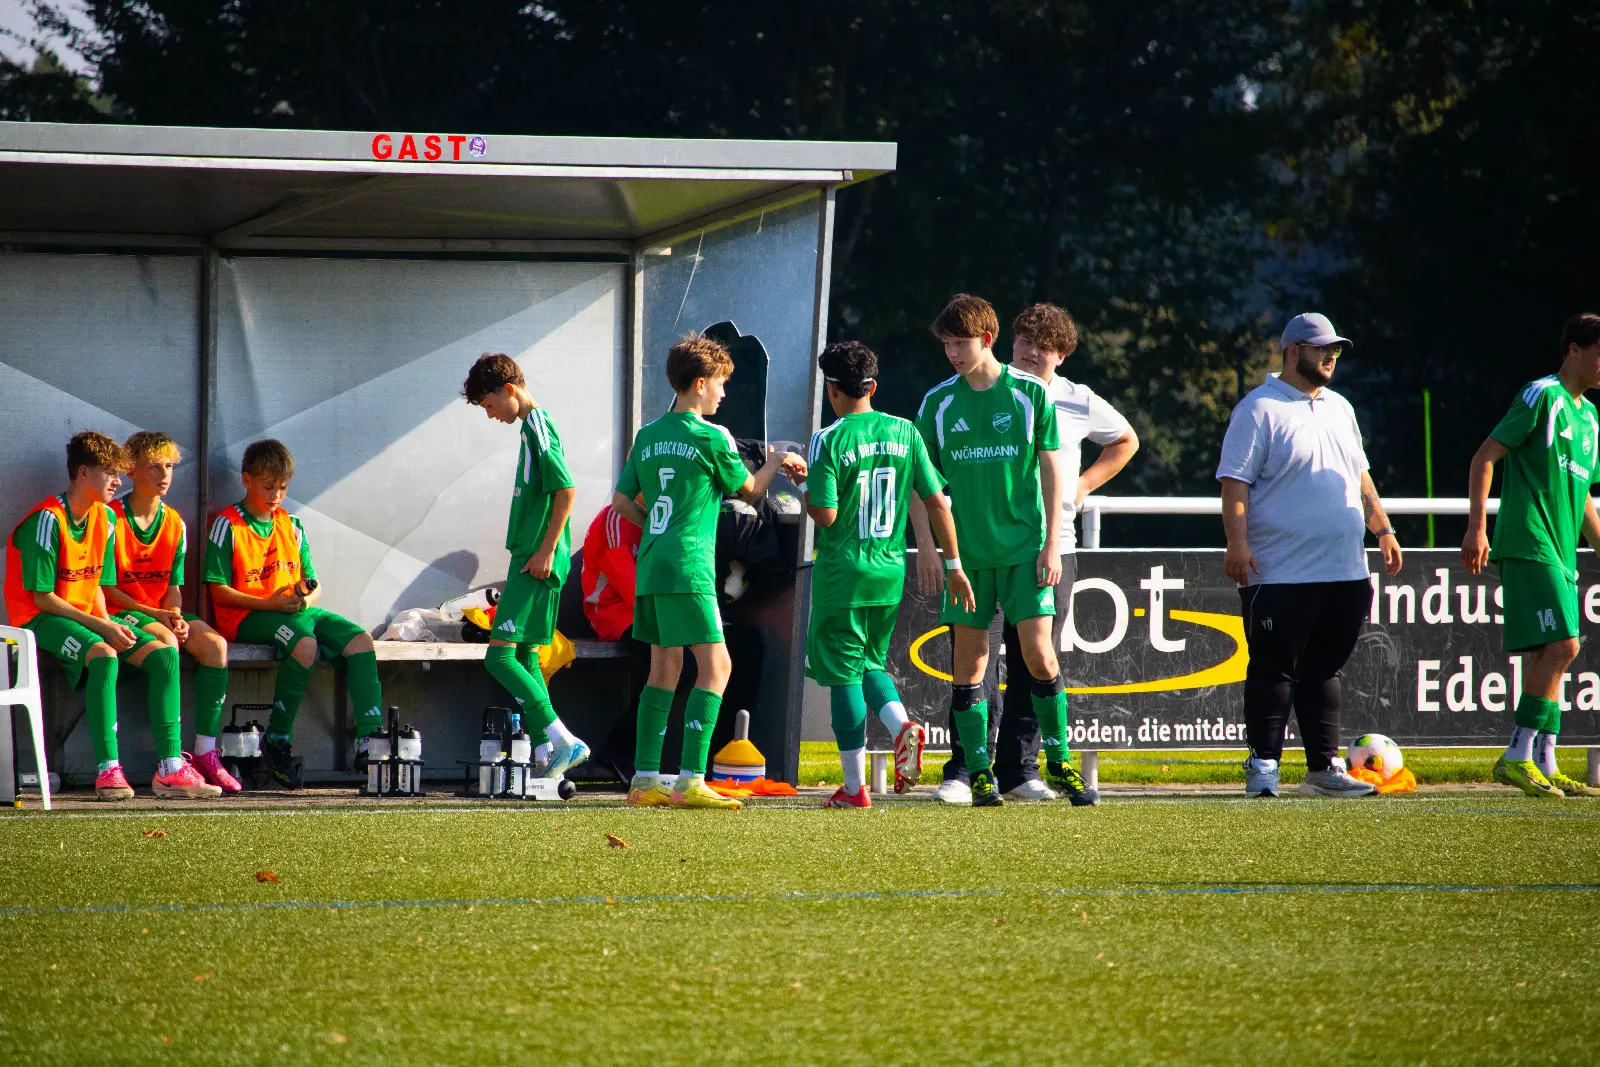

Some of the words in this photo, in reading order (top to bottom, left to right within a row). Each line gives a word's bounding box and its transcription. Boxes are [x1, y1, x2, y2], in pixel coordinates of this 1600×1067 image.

[371, 133, 467, 160] GAST
[654, 441, 698, 461] BROCKDORF
[857, 441, 909, 459] BROCKDORF
[950, 444, 1019, 461] WÖHRMANN
[856, 466, 897, 540] 10
[1536, 608, 1557, 633] 14
[274, 624, 295, 646] 18
[1417, 655, 1600, 712] Edelta
[1137, 717, 1171, 742] die
